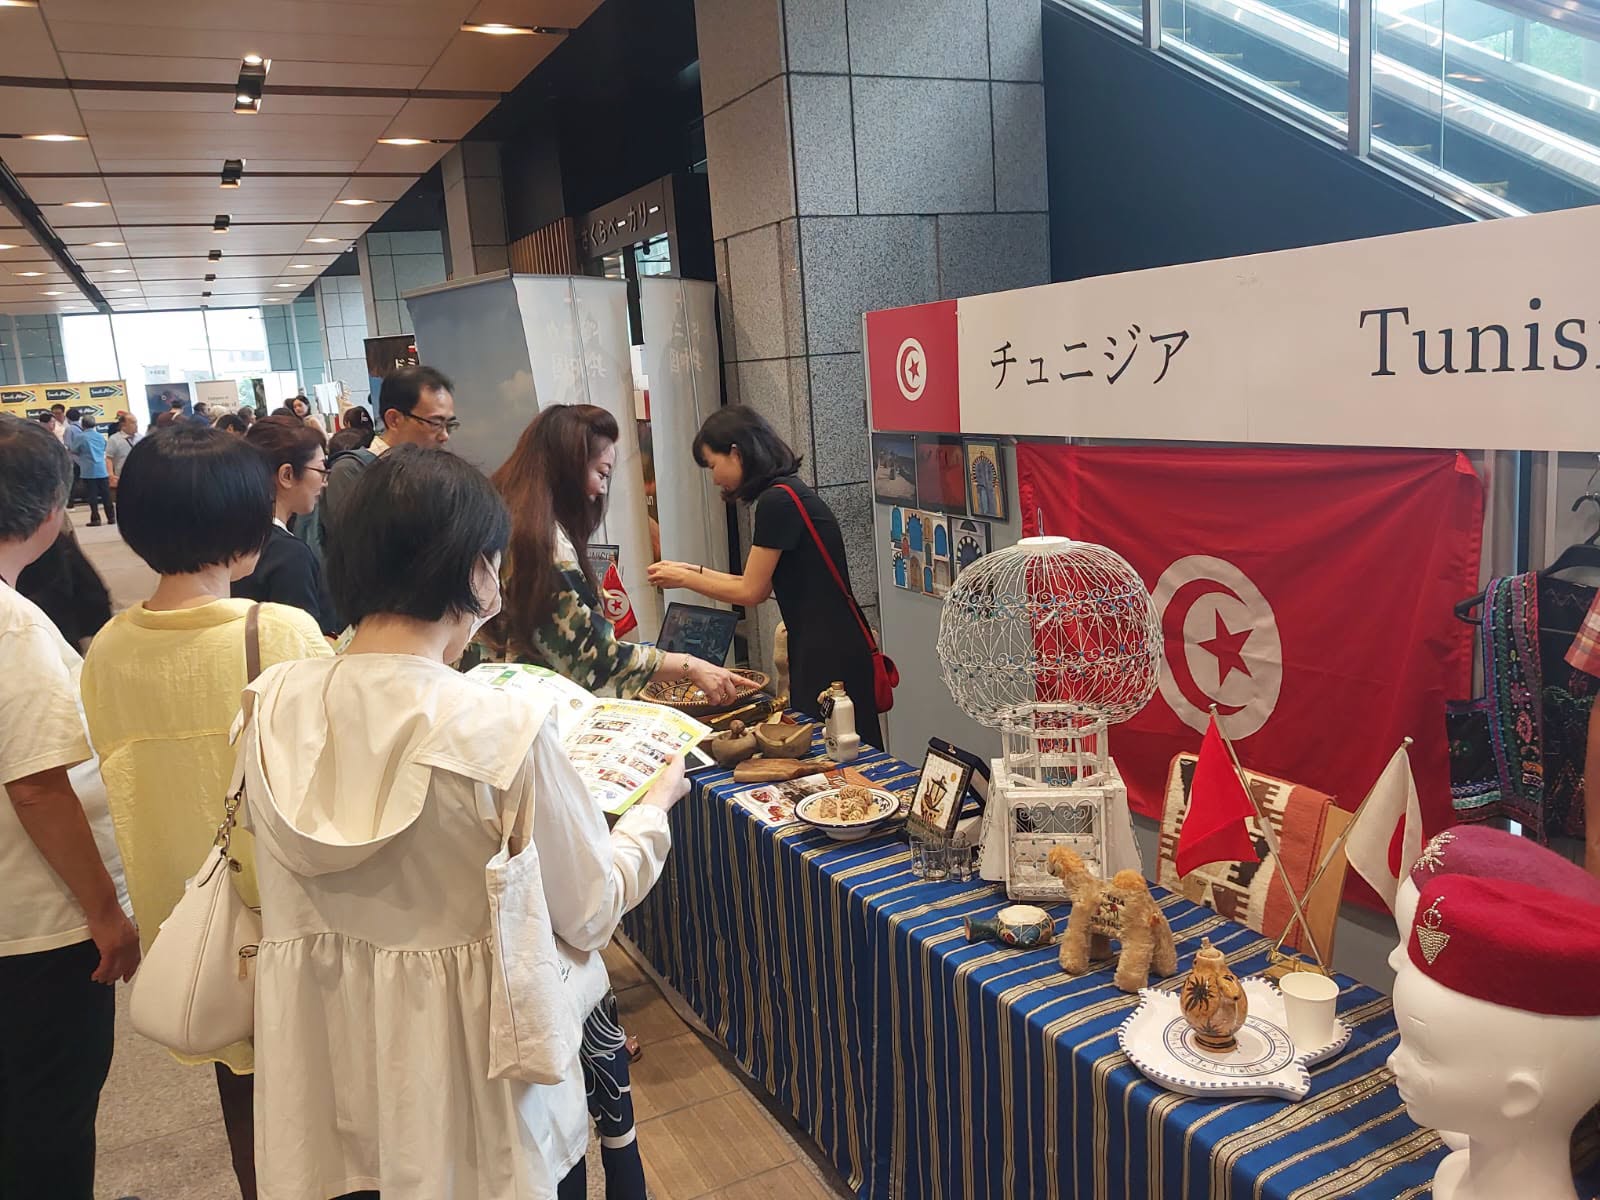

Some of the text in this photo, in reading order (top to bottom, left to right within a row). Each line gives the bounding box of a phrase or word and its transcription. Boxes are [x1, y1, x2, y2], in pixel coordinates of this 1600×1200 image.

[990, 323, 1190, 390] チュニジア
[1359, 297, 1600, 376] Tunis
